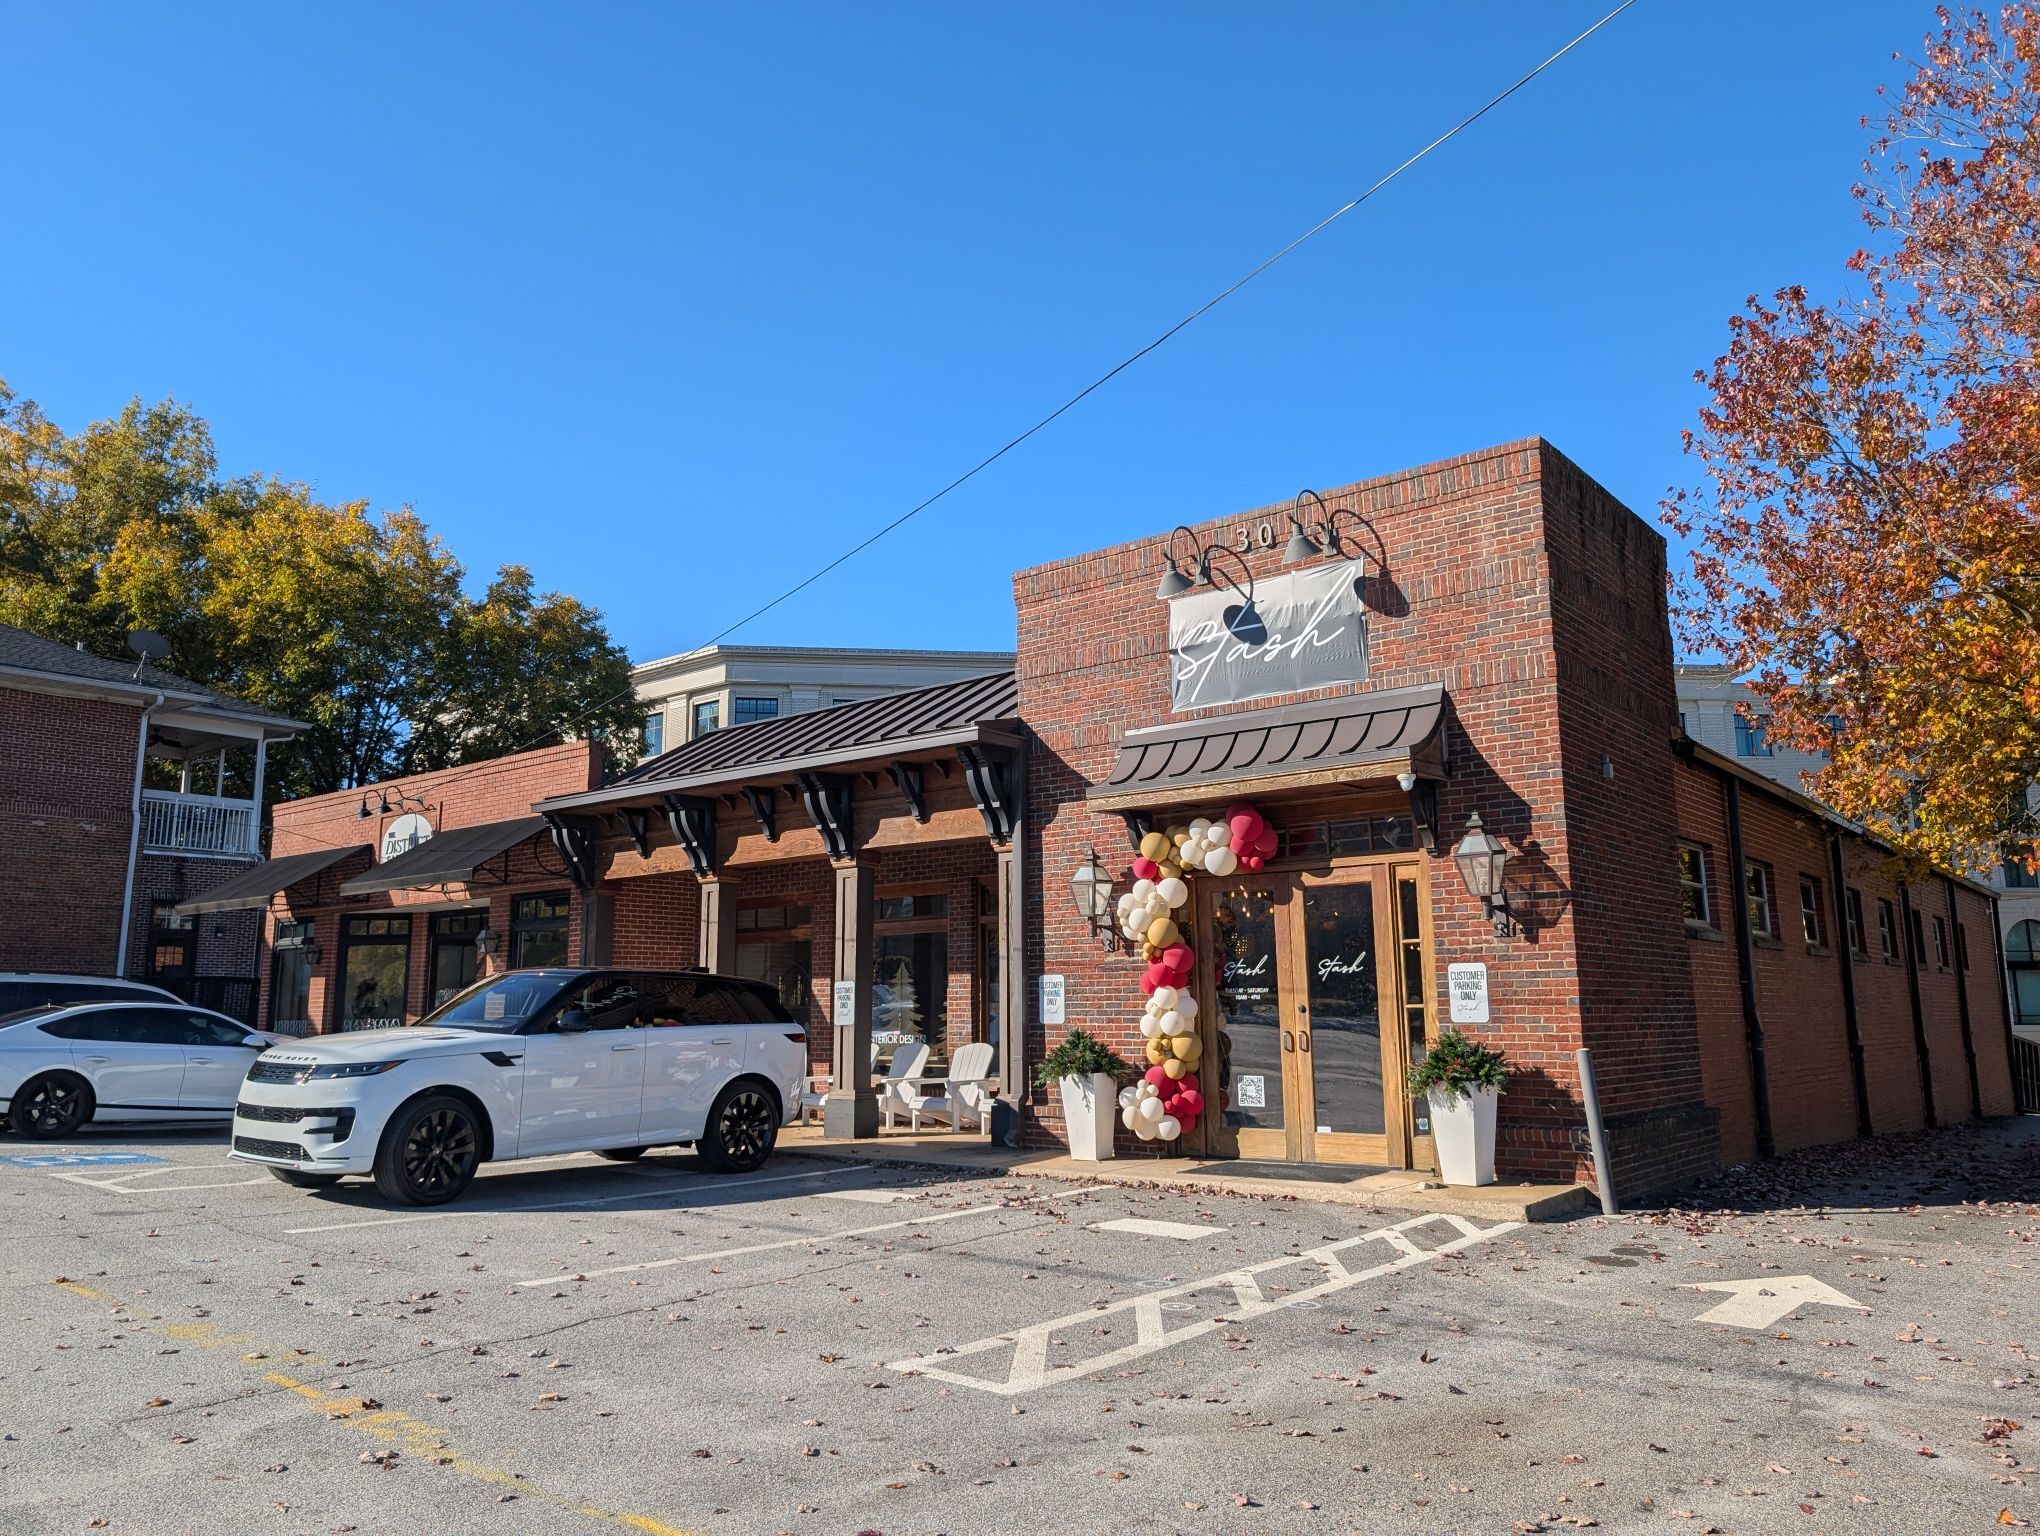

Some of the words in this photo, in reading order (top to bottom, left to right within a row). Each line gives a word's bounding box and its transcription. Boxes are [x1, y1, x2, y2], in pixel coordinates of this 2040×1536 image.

[1236, 523, 1273, 552] 30
[1175, 565, 1356, 703] Stash
[1224, 955, 1268, 982] Stash
[1318, 951, 1366, 982] Stash
[1451, 971, 1484, 980] CUSTOMER
[1454, 981, 1482, 990] PARKING
[1044, 989, 1061, 997] PARKING
[1461, 991, 1476, 1000] ONLY
[899, 1034, 926, 1043] DESIGN
